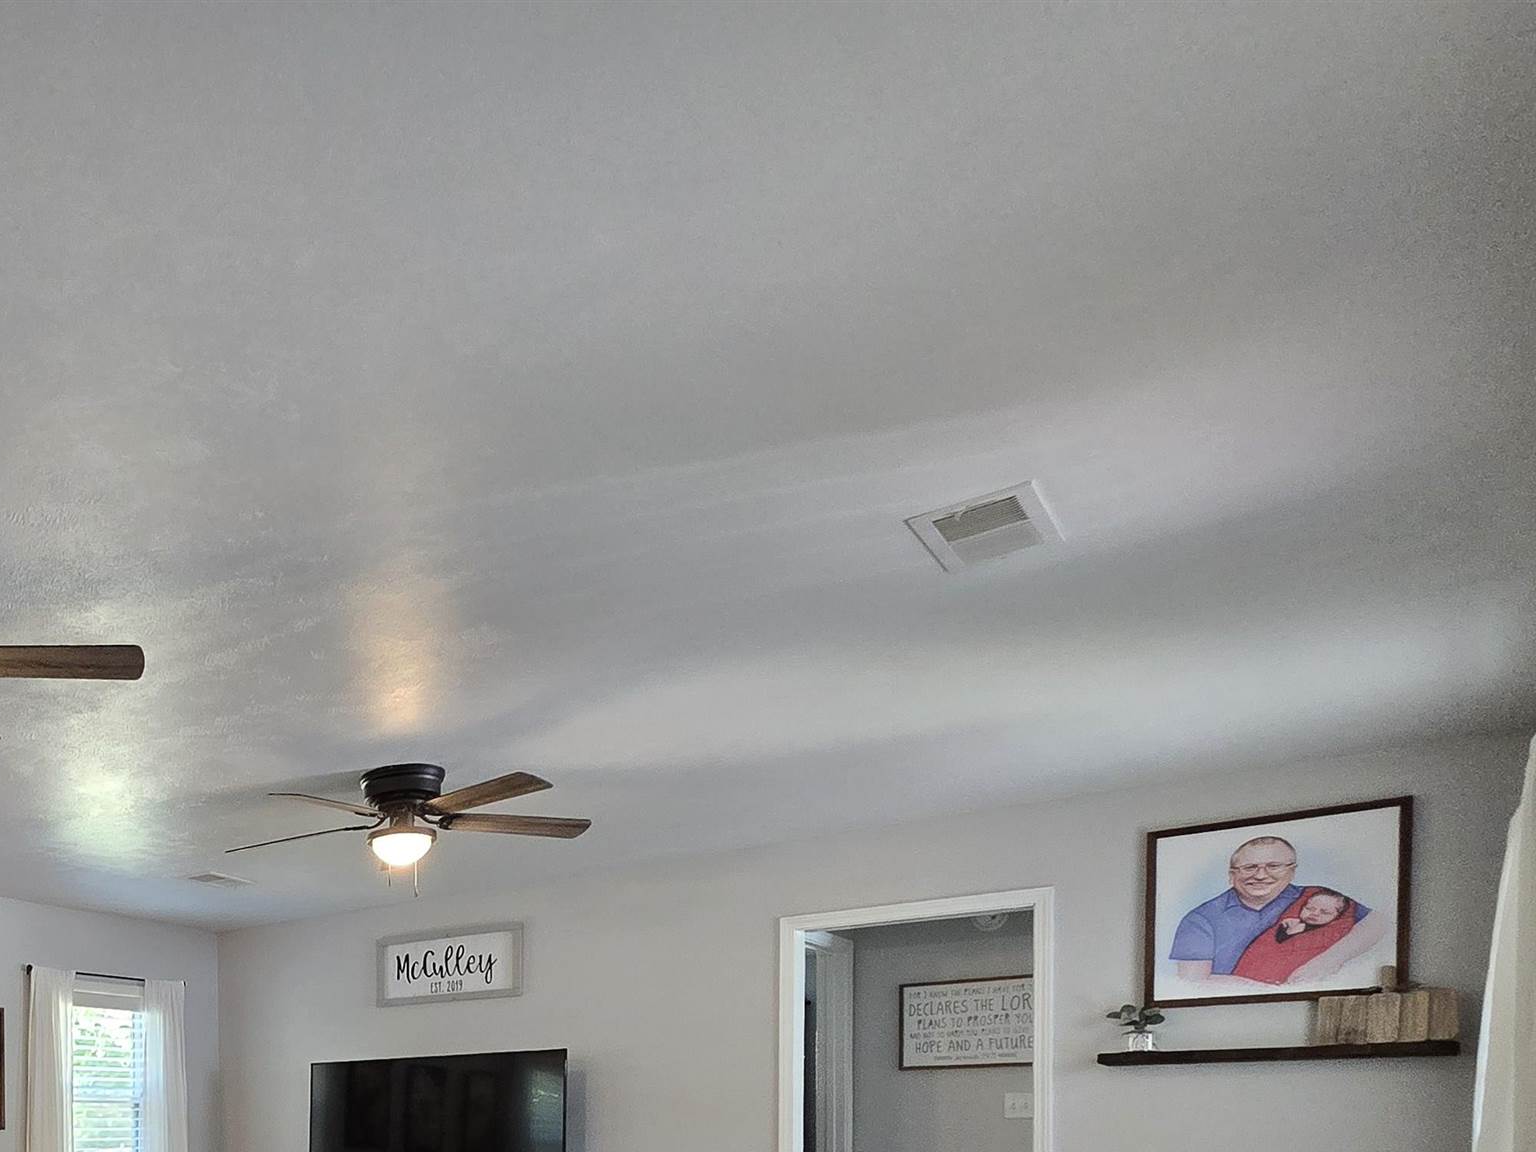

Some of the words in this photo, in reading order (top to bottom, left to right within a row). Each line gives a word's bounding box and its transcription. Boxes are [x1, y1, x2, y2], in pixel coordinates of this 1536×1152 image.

[396, 945, 497, 985] McCulley
[447, 979, 463, 992] 2019
[909, 1000, 968, 1017] DECLARES
[974, 997, 994, 1012] THE
[1001, 993, 1033, 1011] LOR
[915, 1040, 942, 1054] HOPE
[948, 1038, 971, 1052] AND
[976, 1038, 984, 1051] A
[989, 1034, 1033, 1050] FUTURE
